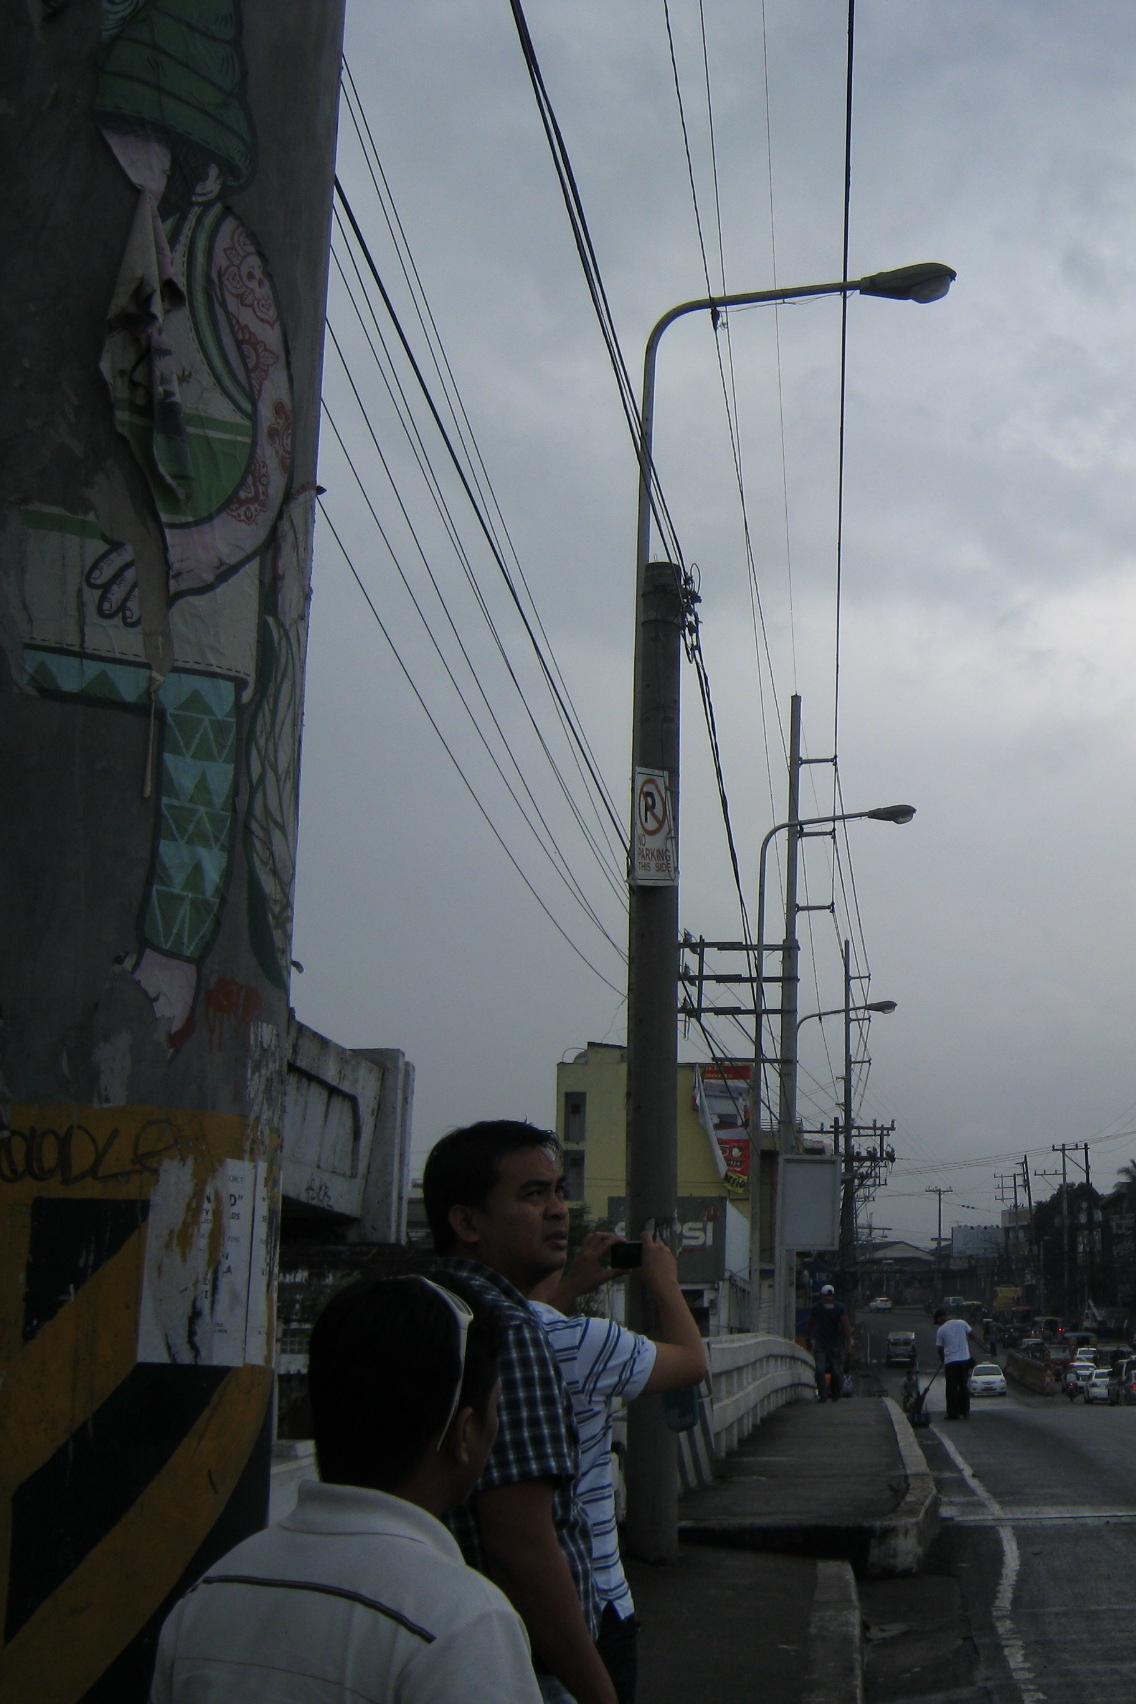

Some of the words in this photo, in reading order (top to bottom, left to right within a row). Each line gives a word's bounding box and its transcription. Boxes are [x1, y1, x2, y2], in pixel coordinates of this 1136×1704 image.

[637, 833, 646, 846] NO
[637, 847, 671, 862] PARKING
[638, 862, 652, 872] THIS
[655, 863, 672, 873] SIDE
